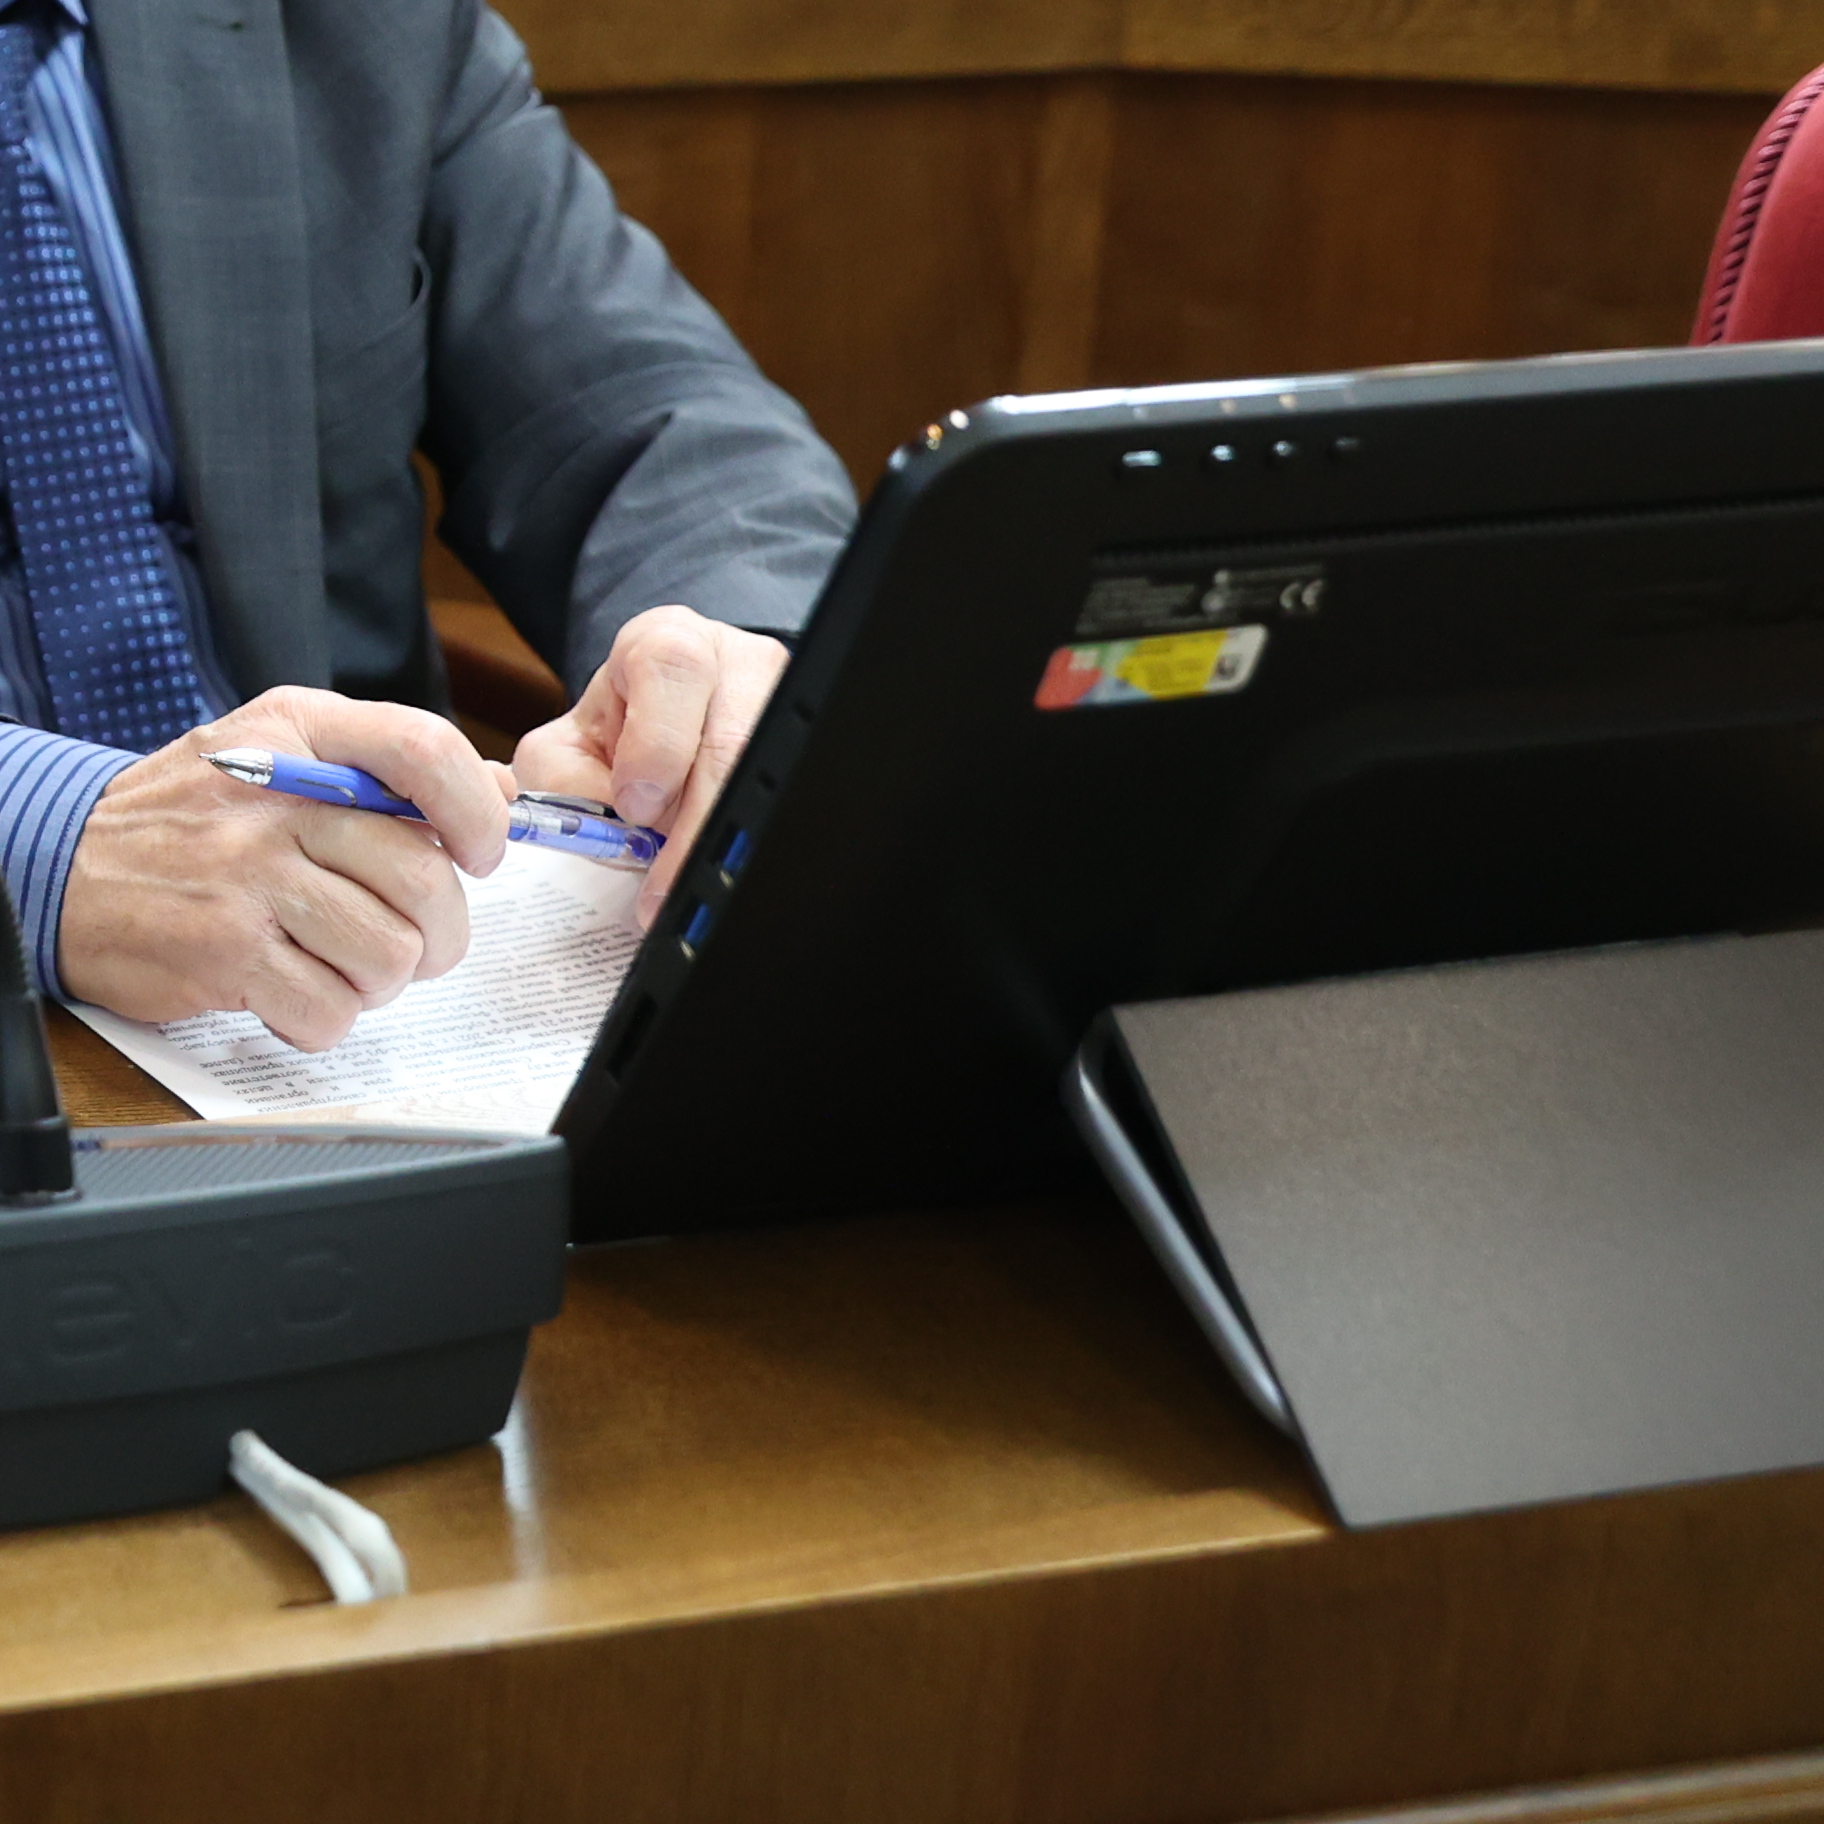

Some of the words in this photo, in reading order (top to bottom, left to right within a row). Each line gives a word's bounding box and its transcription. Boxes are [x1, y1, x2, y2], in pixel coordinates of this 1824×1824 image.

[483, 1022, 537, 1036] декабря
[539, 1018, 558, 1028] 21
[167, 1033, 205, 1043] само-
[451, 1030, 484, 1043] 2021
[178, 1038, 234, 1051] государ-
[398, 1035, 515, 1060] Ставропольского
[455, 1037, 571, 1061] Ставропольского
[198, 1056, 244, 1069] (далее
[286, 1054, 333, 1067] общих
[351, 1056, 383, 1067] края
[404, 1057, 443, 1070] края»
[415, 1054, 531, 1078] Ставропольского
[527, 1059, 570, 1070] между
[209, 1060, 285, 1078] принципах
[305, 1065, 392, 1084] подготовлен
[452, 1067, 515, 1083] органами
[221, 1067, 310, 1086] соответствие
[361, 1076, 393, 1086] края
[231, 1084, 273, 1095] целях
[377, 1080, 440, 1094] местного
[243, 1087, 309, 1104] органами
[256, 1090, 366, 1113] самоуправления
